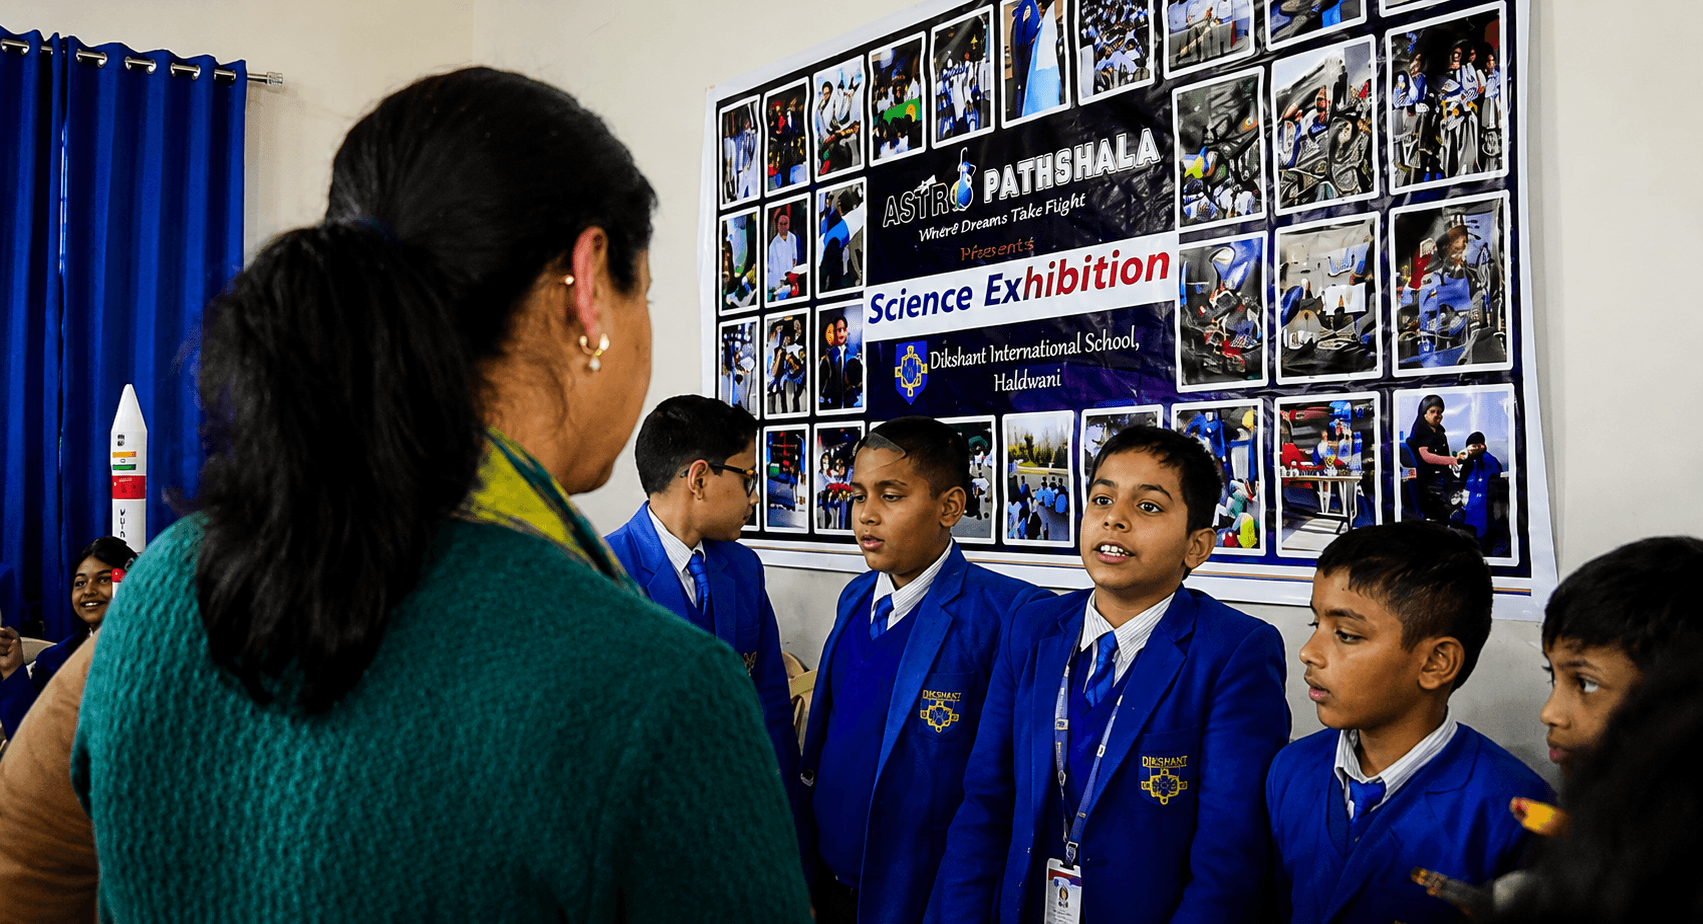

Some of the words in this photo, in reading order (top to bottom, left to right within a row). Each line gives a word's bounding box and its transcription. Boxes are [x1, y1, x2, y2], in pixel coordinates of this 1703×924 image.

[983, 127, 1162, 204] PATHSHALA
[960, 214, 1008, 234] Dreams
[1011, 206, 1043, 223] Take
[1045, 193, 1086, 216] Flight
[960, 237, 1035, 261] Presents
[867, 286, 973, 325] Science
[984, 249, 1170, 307] Exhibition
[930, 346, 986, 370] Dikshant
[990, 332, 1081, 363] International
[1084, 325, 1140, 353] School,
[993, 368, 1062, 392] Haldwani
